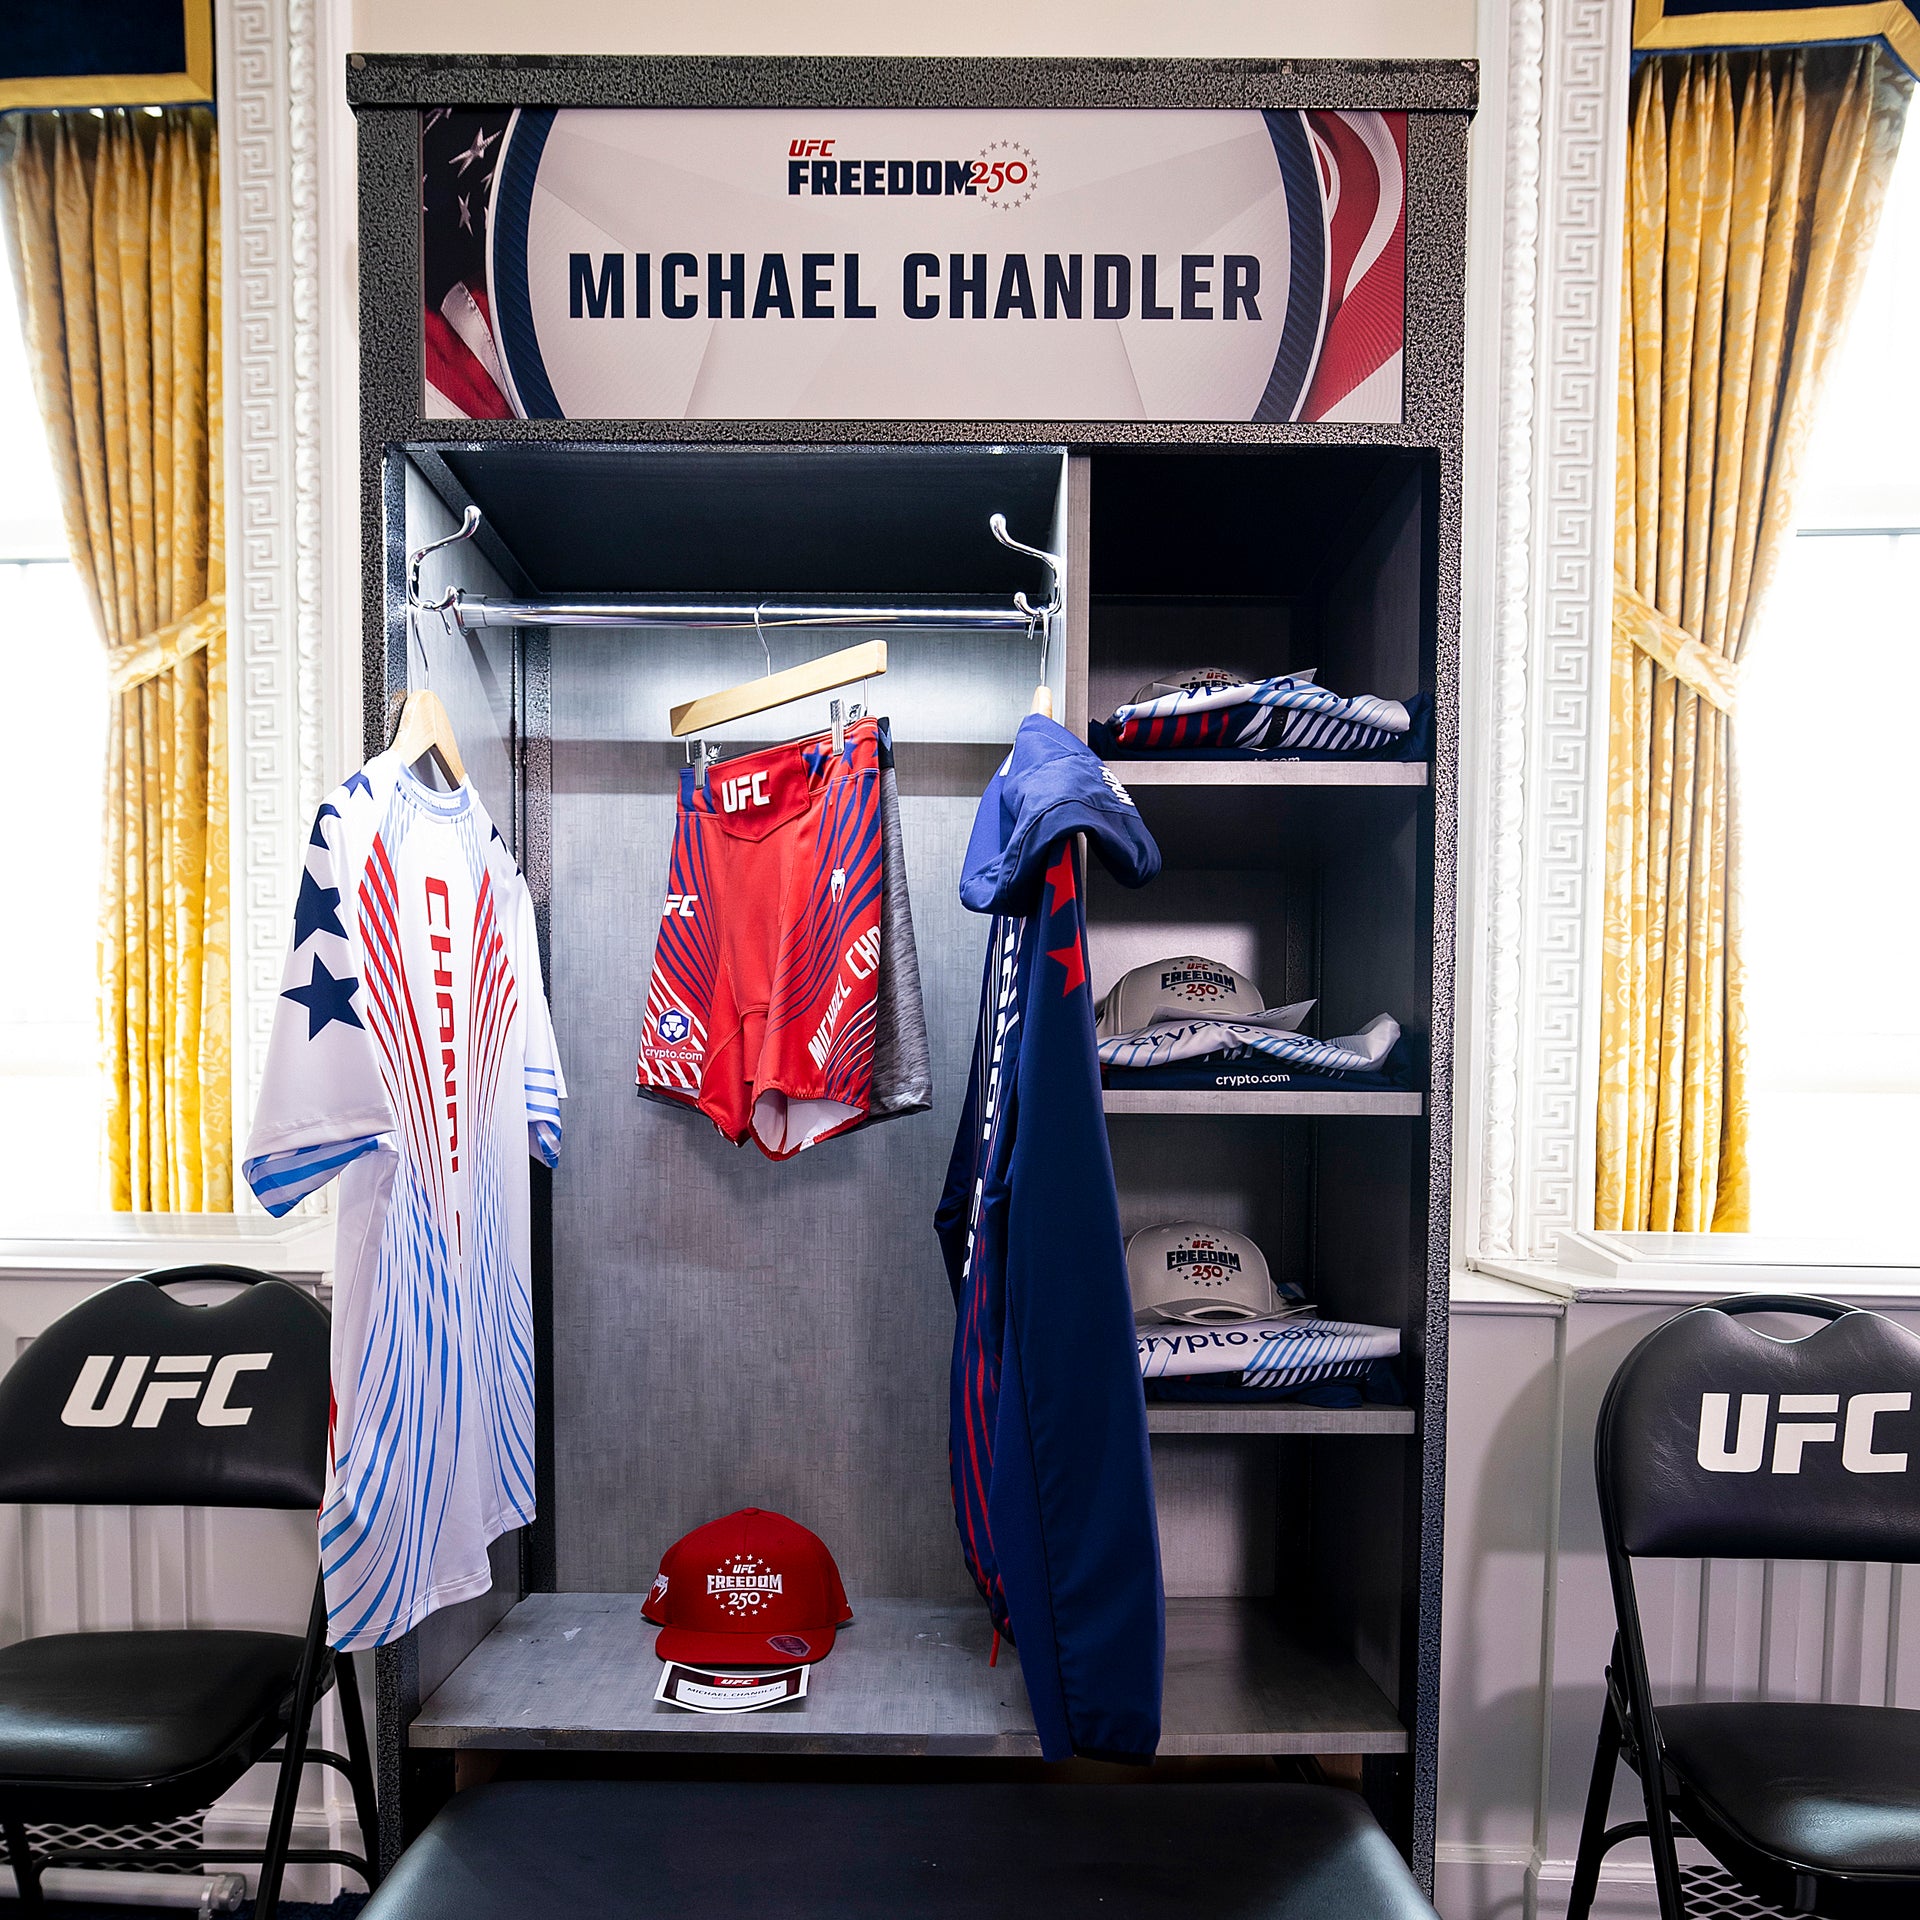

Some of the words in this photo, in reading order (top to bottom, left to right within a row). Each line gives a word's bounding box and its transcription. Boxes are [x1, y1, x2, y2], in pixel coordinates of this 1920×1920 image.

[788, 139, 835, 157] UFC
[788, 160, 977, 196] FREEDOM
[970, 161, 1029, 193] 250
[569, 253, 876, 319] MICHAEL
[902, 253, 1261, 320] CHANDLER
[721, 770, 771, 813] UFC
[663, 894, 698, 917] FC
[1187, 962, 1209, 971] UFC
[1161, 970, 1236, 994] FREEDOM
[1186, 982, 1218, 997] 250
[645, 1047, 703, 1061] crypto.com
[1215, 1072, 1291, 1086] crypto.com
[1192, 1240, 1214, 1249] UFC
[1166, 1250, 1242, 1272] FREEDOM
[1191, 1264, 1223, 1280] 250
[60, 1353, 273, 1428] UFC
[1697, 1392, 1912, 1474] UFC
[732, 1564, 757, 1574] UFC
[707, 1574, 783, 1595] FREEDOM
[728, 1592, 761, 1609] 250
